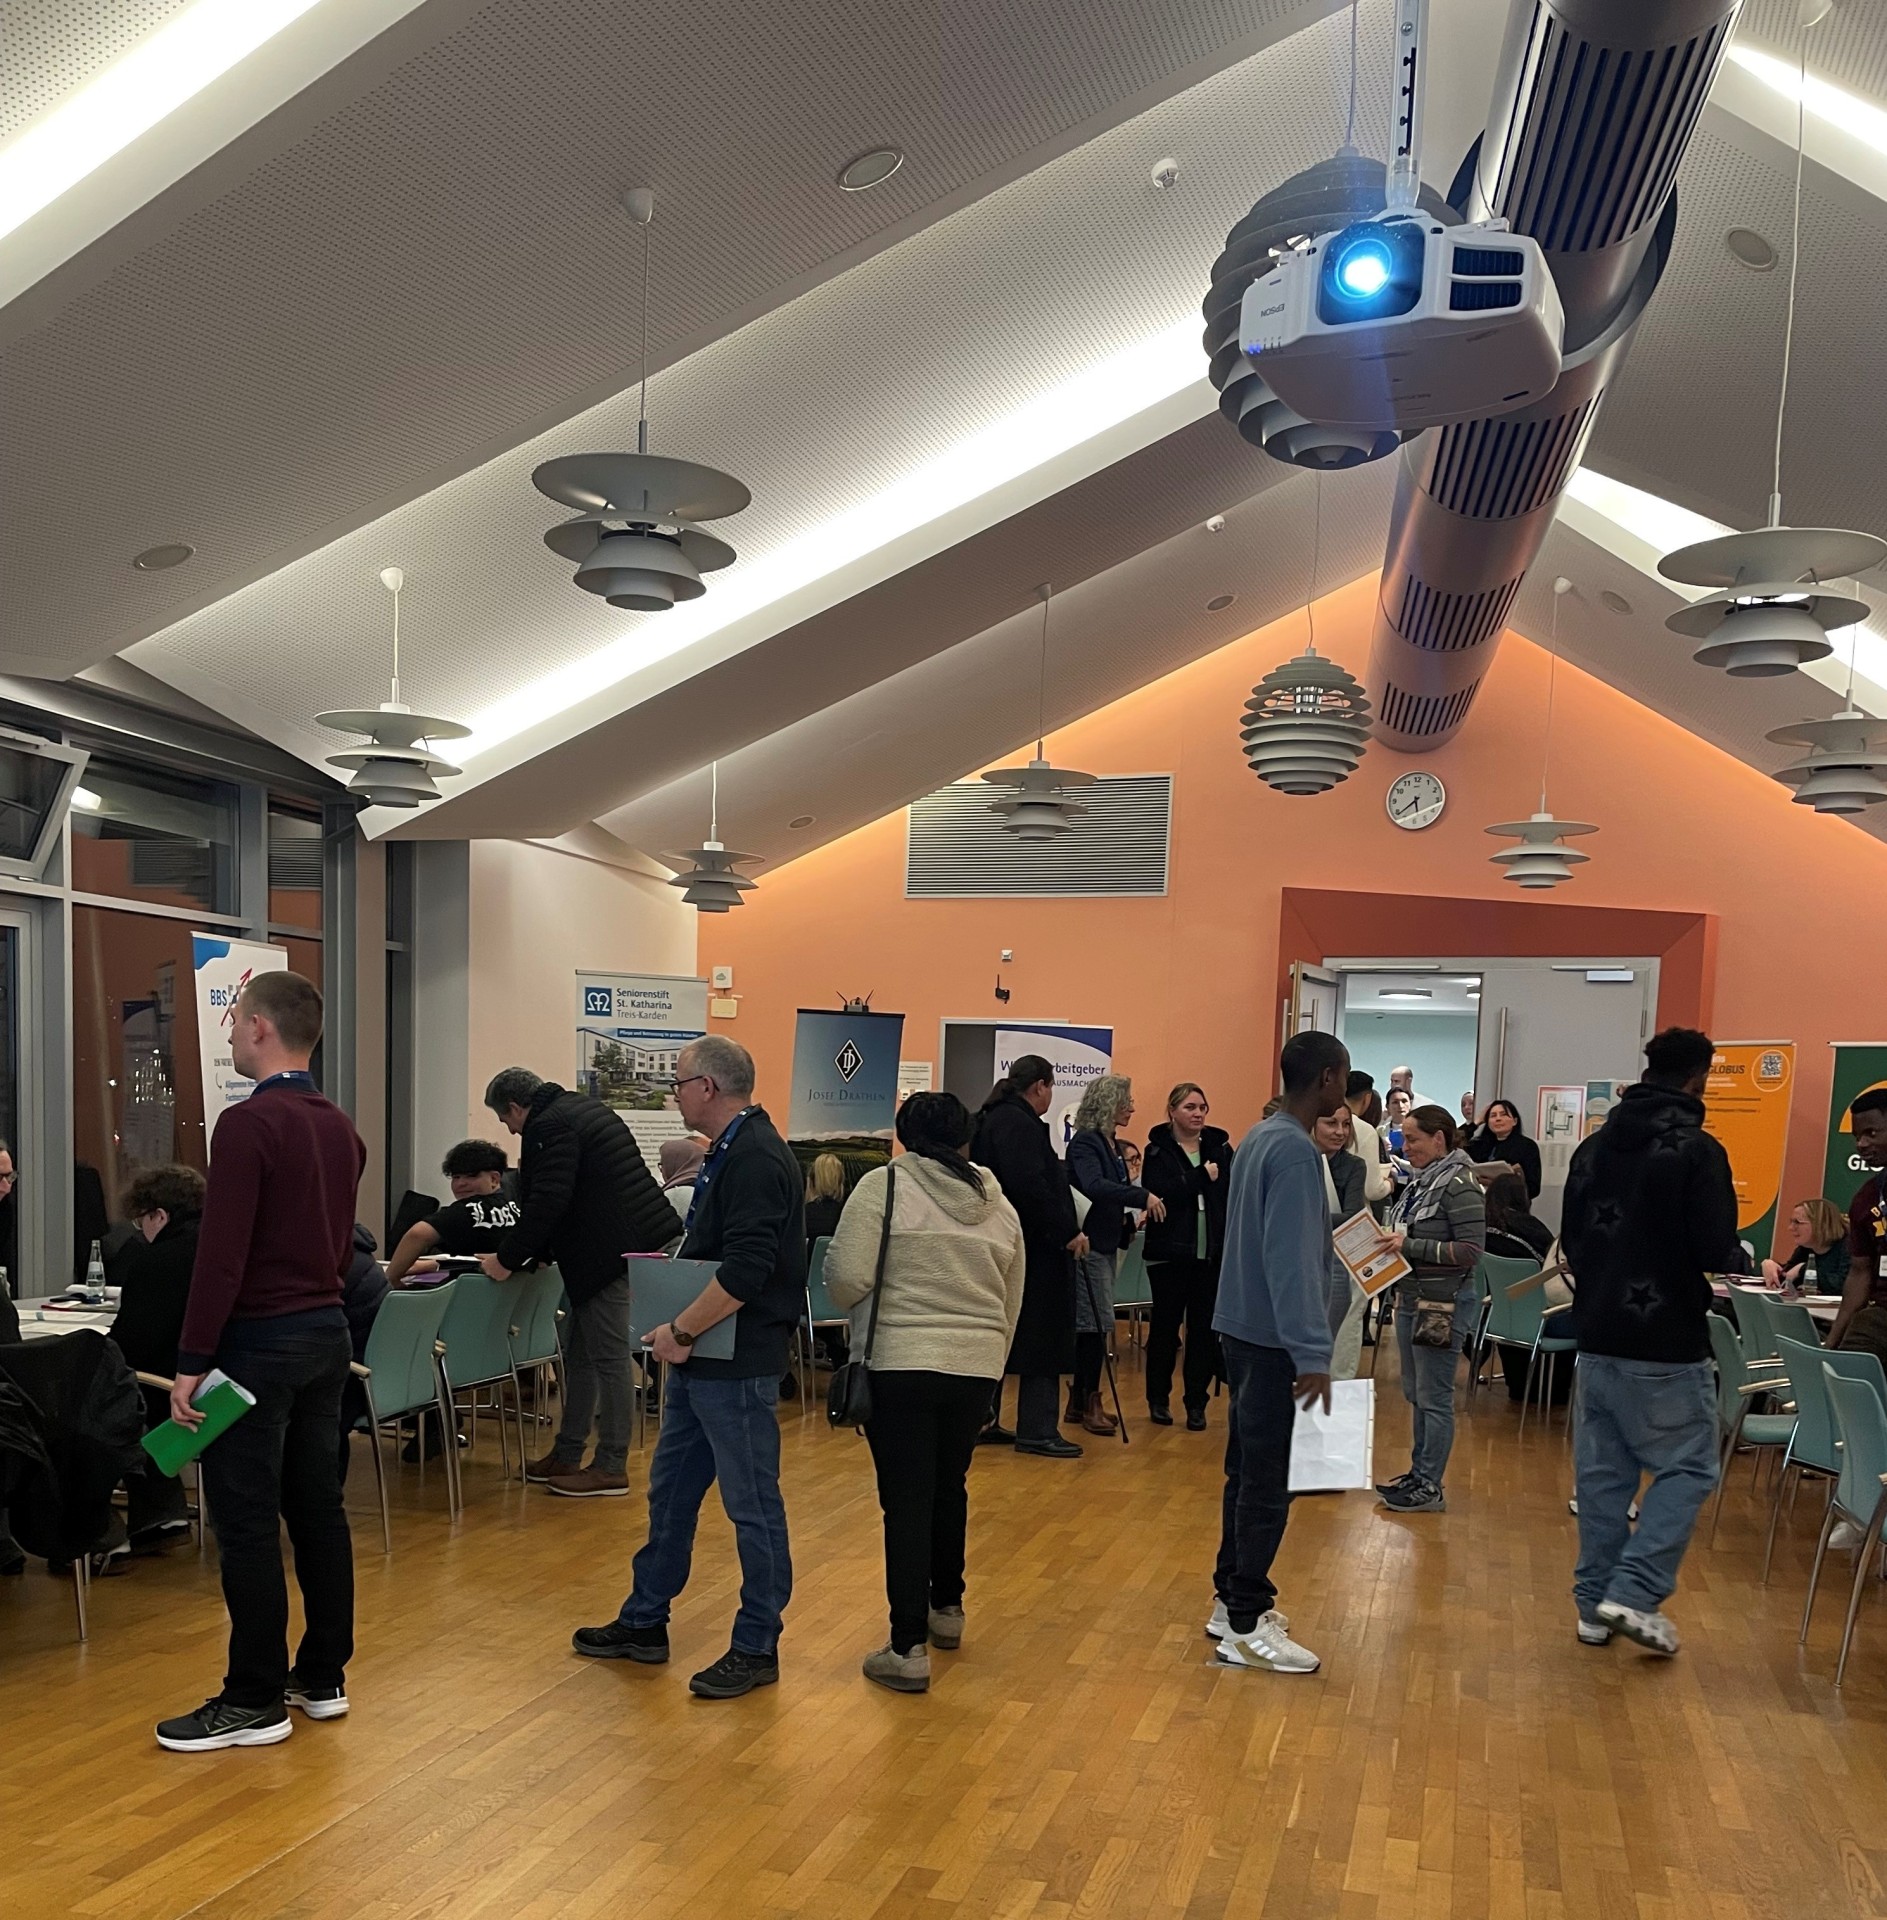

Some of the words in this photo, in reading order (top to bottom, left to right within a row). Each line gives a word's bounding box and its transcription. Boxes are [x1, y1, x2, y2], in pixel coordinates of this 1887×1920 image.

[1261, 303, 1285, 317] EPSON
[210, 989, 227, 1006] BBS
[616, 988, 669, 999] Seniorenstift
[616, 999, 628, 1008] St.
[631, 1000, 672, 1010] Katharina
[617, 1010, 667, 1020] Treis-Karden
[1053, 1062, 1106, 1076] beitgeber
[1053, 1080, 1089, 1088] AUSMACH
[1847, 1154, 1885, 1172] GL
